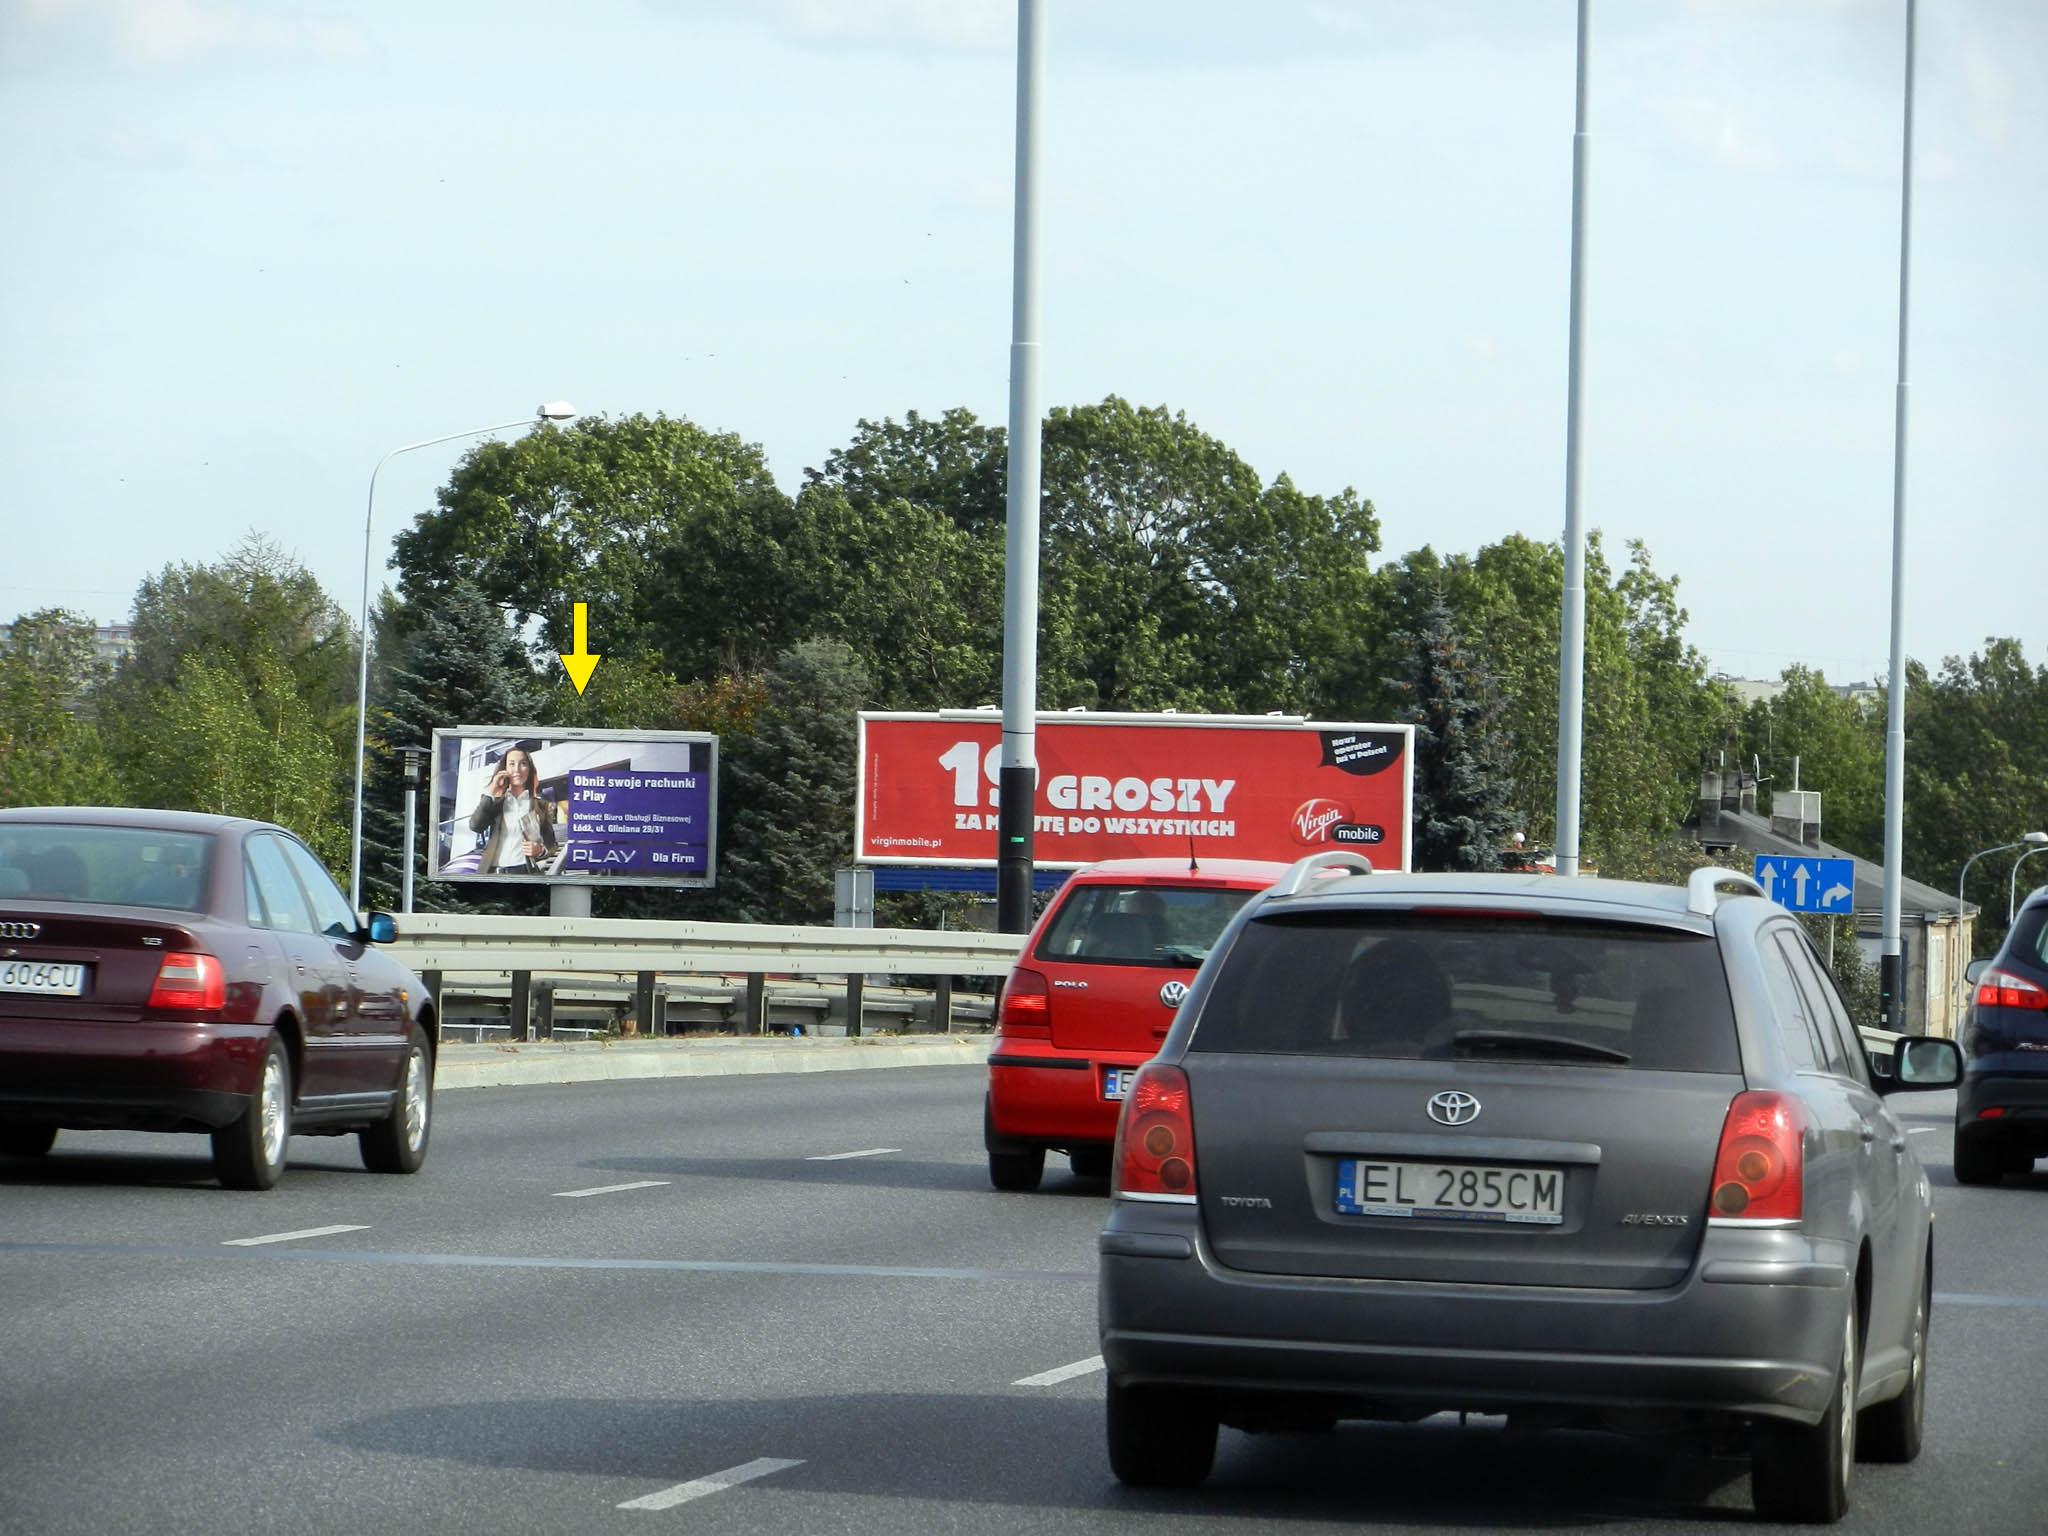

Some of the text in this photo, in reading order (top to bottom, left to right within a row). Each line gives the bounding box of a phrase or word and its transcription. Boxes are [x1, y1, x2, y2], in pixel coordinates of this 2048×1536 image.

[574, 775, 696, 790] Obniż swoje rachunki
[574, 790, 607, 803] z Play
[1047, 775, 1236, 813] GROSZY
[604, 813, 623, 821] Biuro
[652, 814, 692, 824] Biznesowej
[955, 813, 1236, 837] ZA MTĘ DO WSZYSTKICH
[1296, 799, 1343, 842] Virgin
[596, 825, 606, 833] ul.
[1338, 827, 1379, 841] mobile
[871, 836, 942, 848] virginmobile.pl
[572, 849, 637, 863] PLAY
[653, 853, 695, 863] Dla Firm
[3, 963, 78, 988] 606CU
[1054, 980, 1088, 989] POLO
[1339, 1187, 1353, 1198] PL
[1363, 1164, 1557, 1211] EL 285CM
[1220, 1196, 1272, 1209] TOYOTA
[1621, 1214, 1688, 1225] AVENSIS
